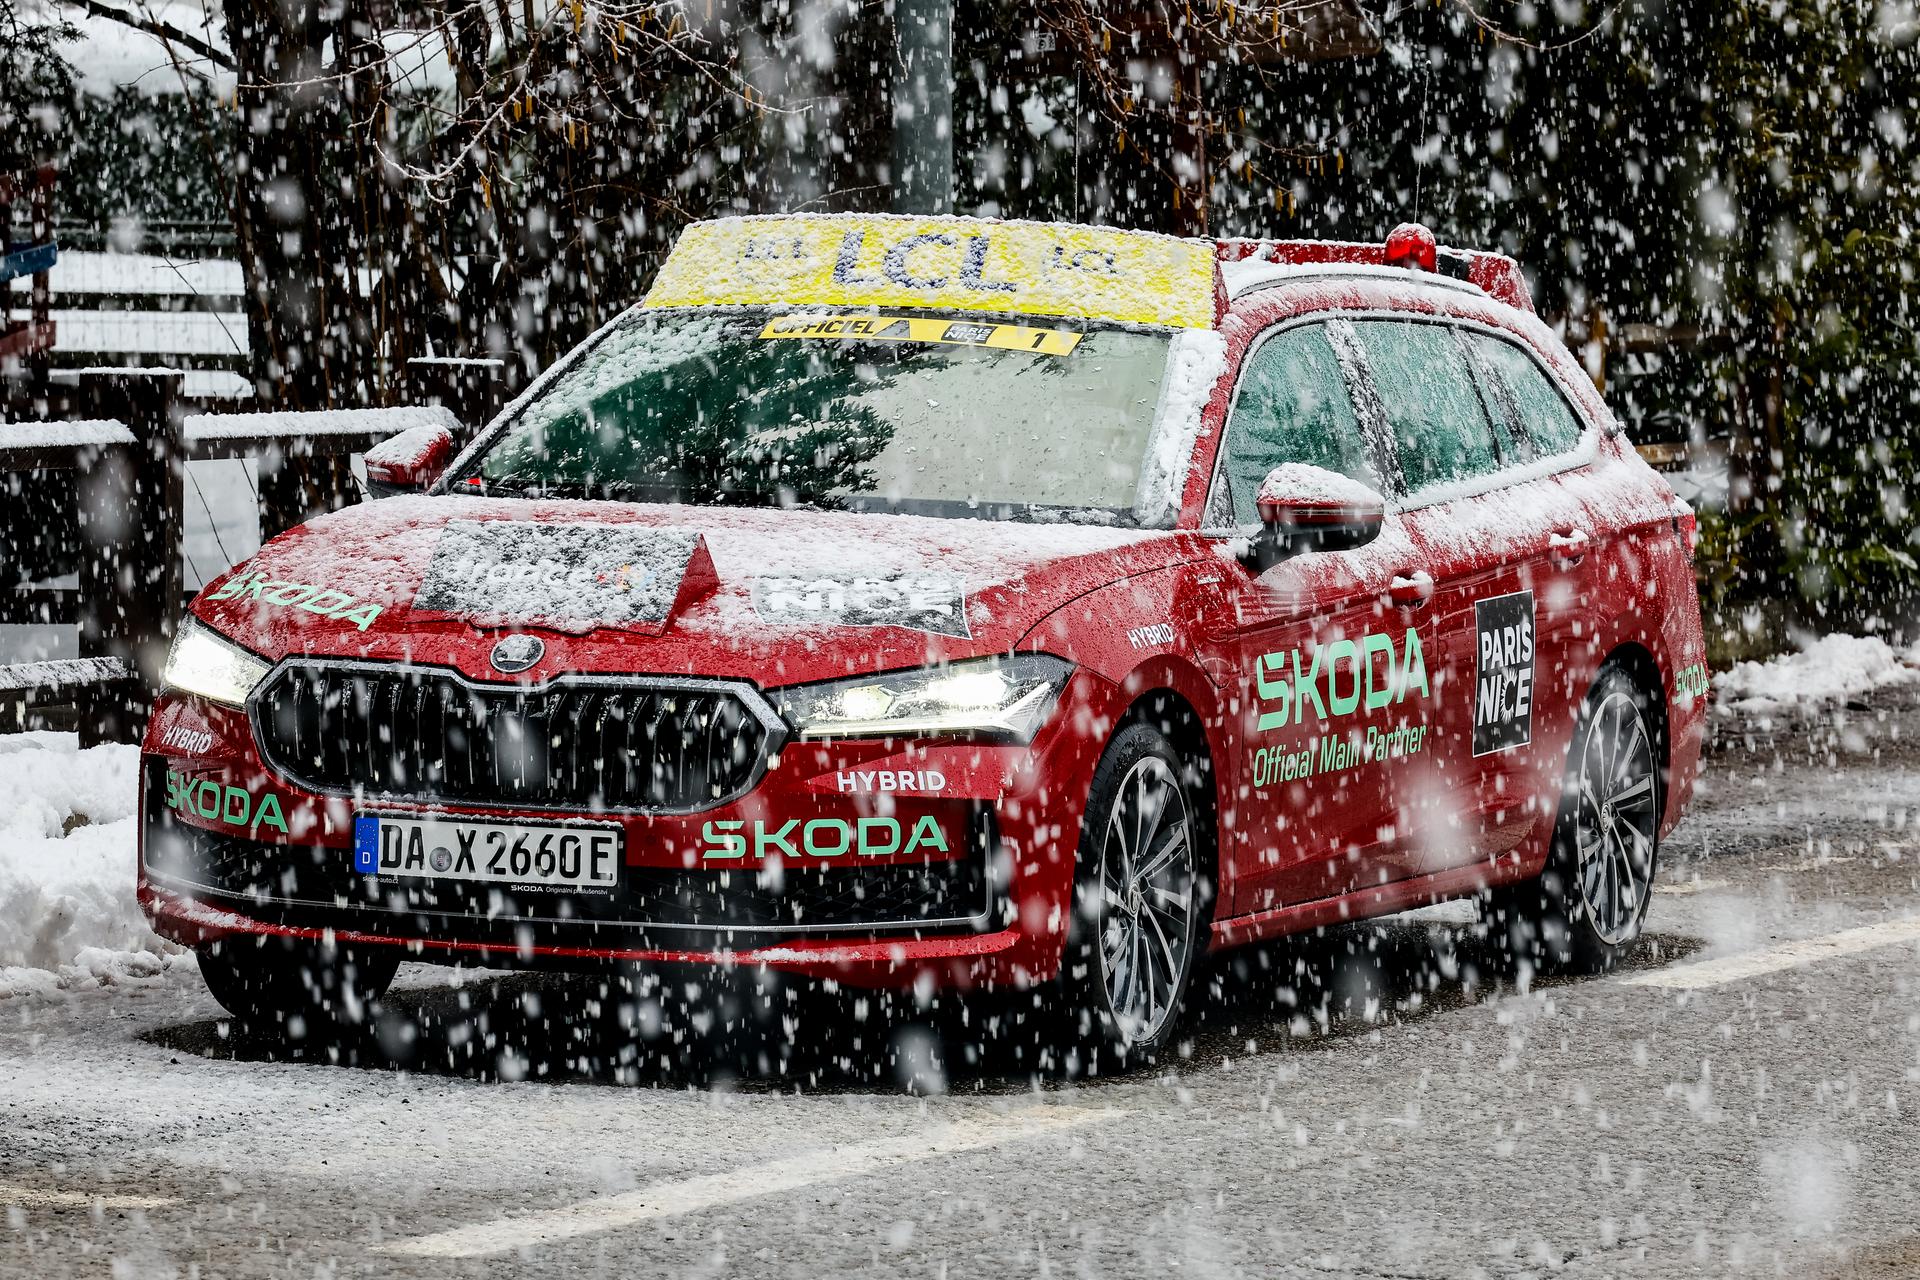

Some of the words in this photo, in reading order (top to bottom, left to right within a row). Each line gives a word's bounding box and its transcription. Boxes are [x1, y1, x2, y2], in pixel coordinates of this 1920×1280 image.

[832, 230, 1017, 293] LCL
[1030, 332, 1047, 348] 1
[1126, 623, 1175, 649] HYBRID
[1481, 623, 1533, 671] PARIS
[1478, 667, 1532, 726] NICE
[161, 725, 212, 753] HYBRID
[1253, 744, 1315, 787] Official
[1319, 734, 1360, 774] Main
[1364, 724, 1427, 764] Partner
[837, 770, 946, 792] HYBRID
[362, 852, 371, 864] D
[380, 824, 426, 870] DA
